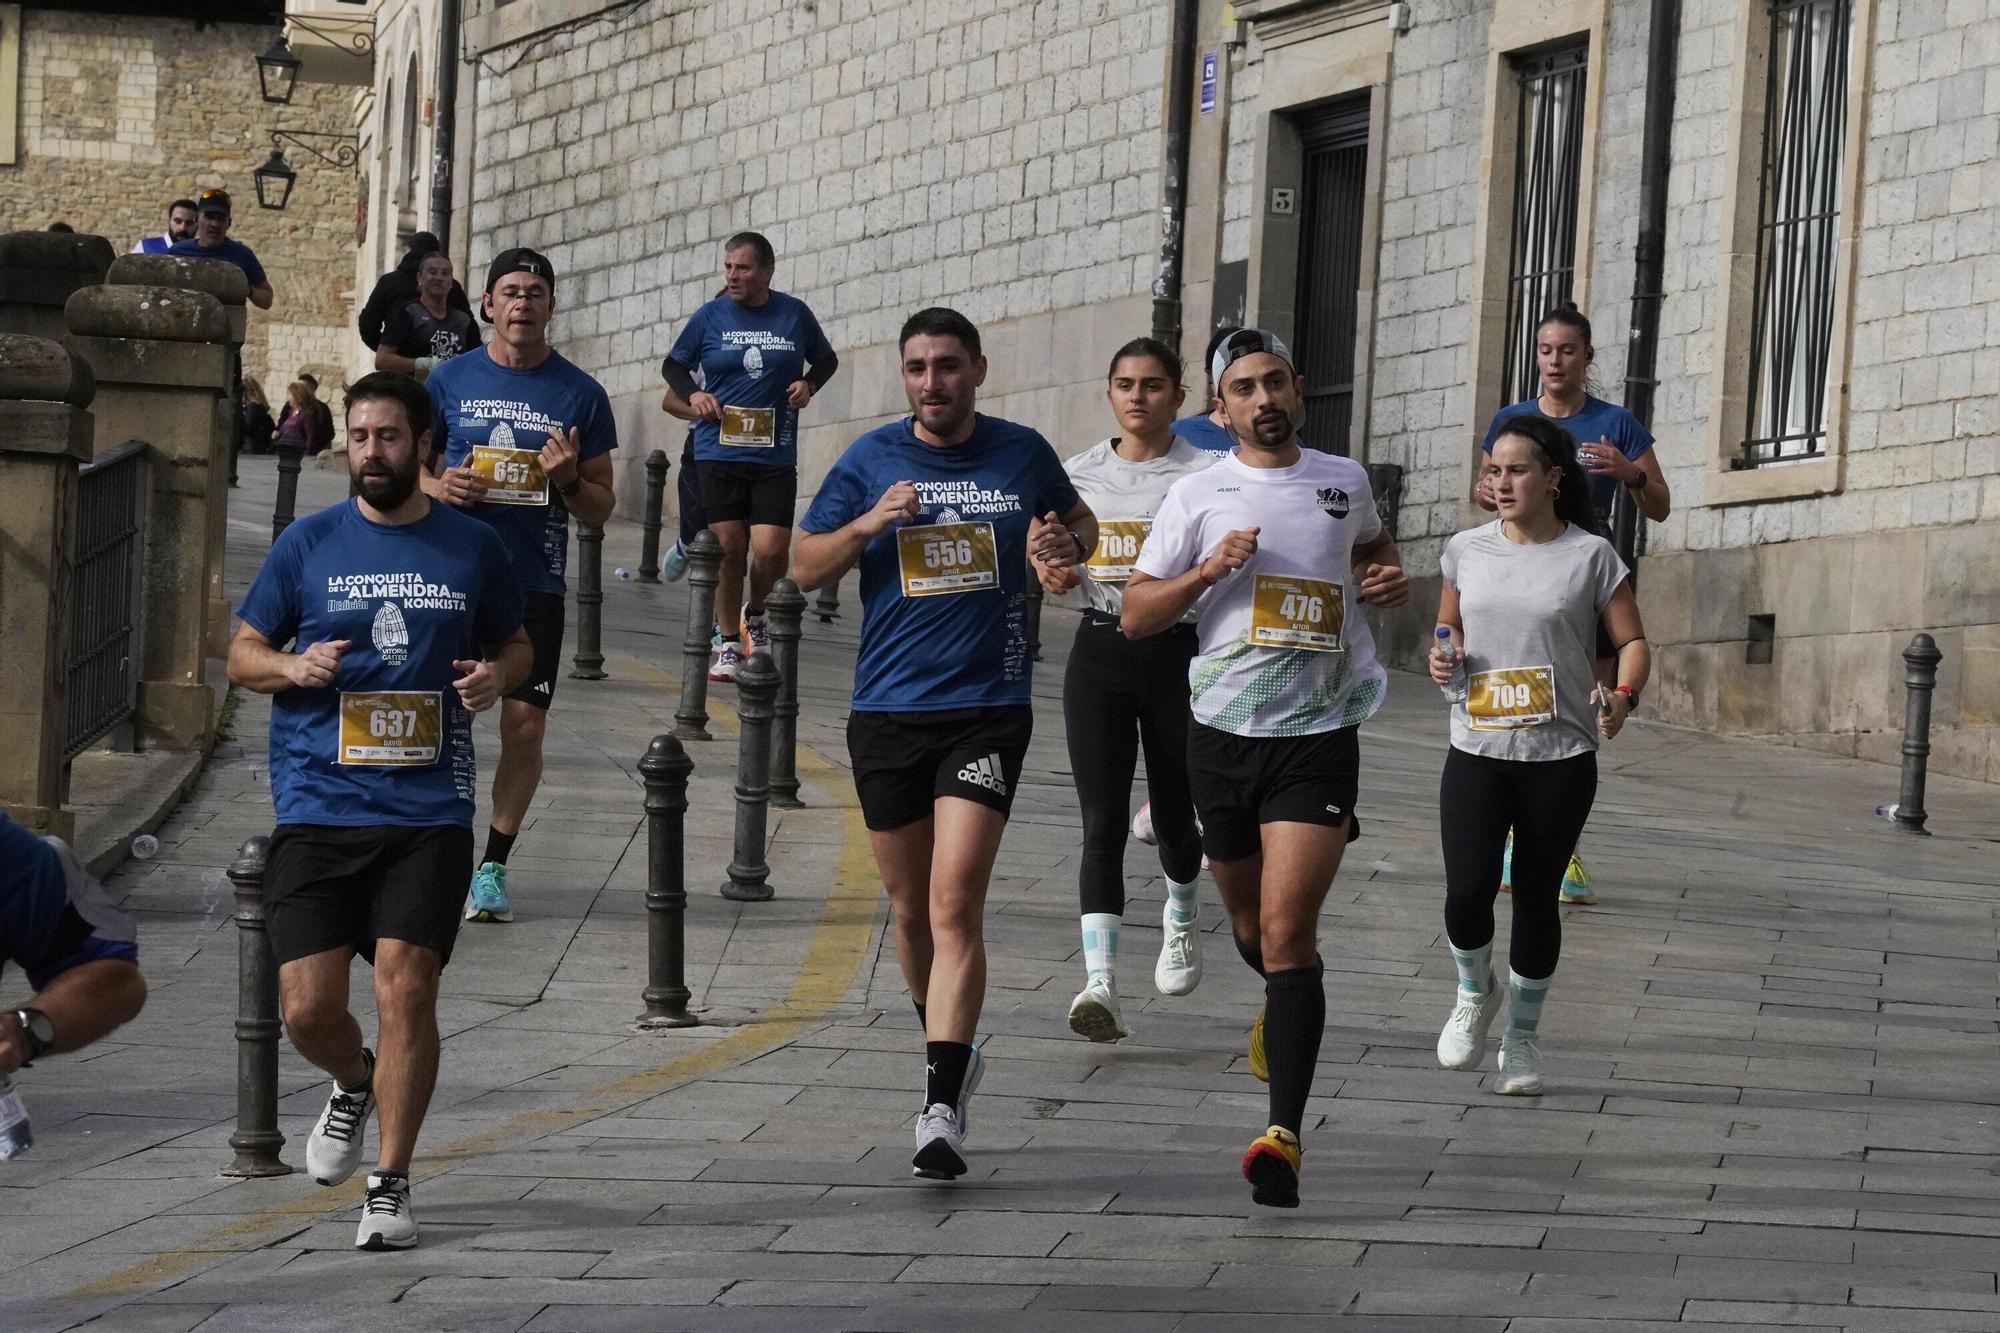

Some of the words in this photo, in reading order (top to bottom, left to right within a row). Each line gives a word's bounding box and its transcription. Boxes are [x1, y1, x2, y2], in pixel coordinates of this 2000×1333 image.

[1276, 192, 1289, 209] 5
[473, 400, 530, 411] CONQUISTA
[474, 408, 550, 425] ALMENDRA
[742, 418, 755, 432] 17
[494, 461, 529, 483] 657
[912, 481, 978, 492] ONQUISTA
[962, 502, 1022, 514] KONKISTA
[924, 540, 972, 568] 556
[1098, 535, 1136, 558] 708
[328, 577, 343, 586] LA
[345, 573, 423, 586] CONQUISTA
[348, 584, 451, 598] ALMENDRA
[404, 598, 466, 611] KONKISTA
[1280, 594, 1323, 623] 476
[1489, 684, 1530, 709] 709
[370, 710, 416, 737] 637
[957, 768, 1006, 796] adidas
